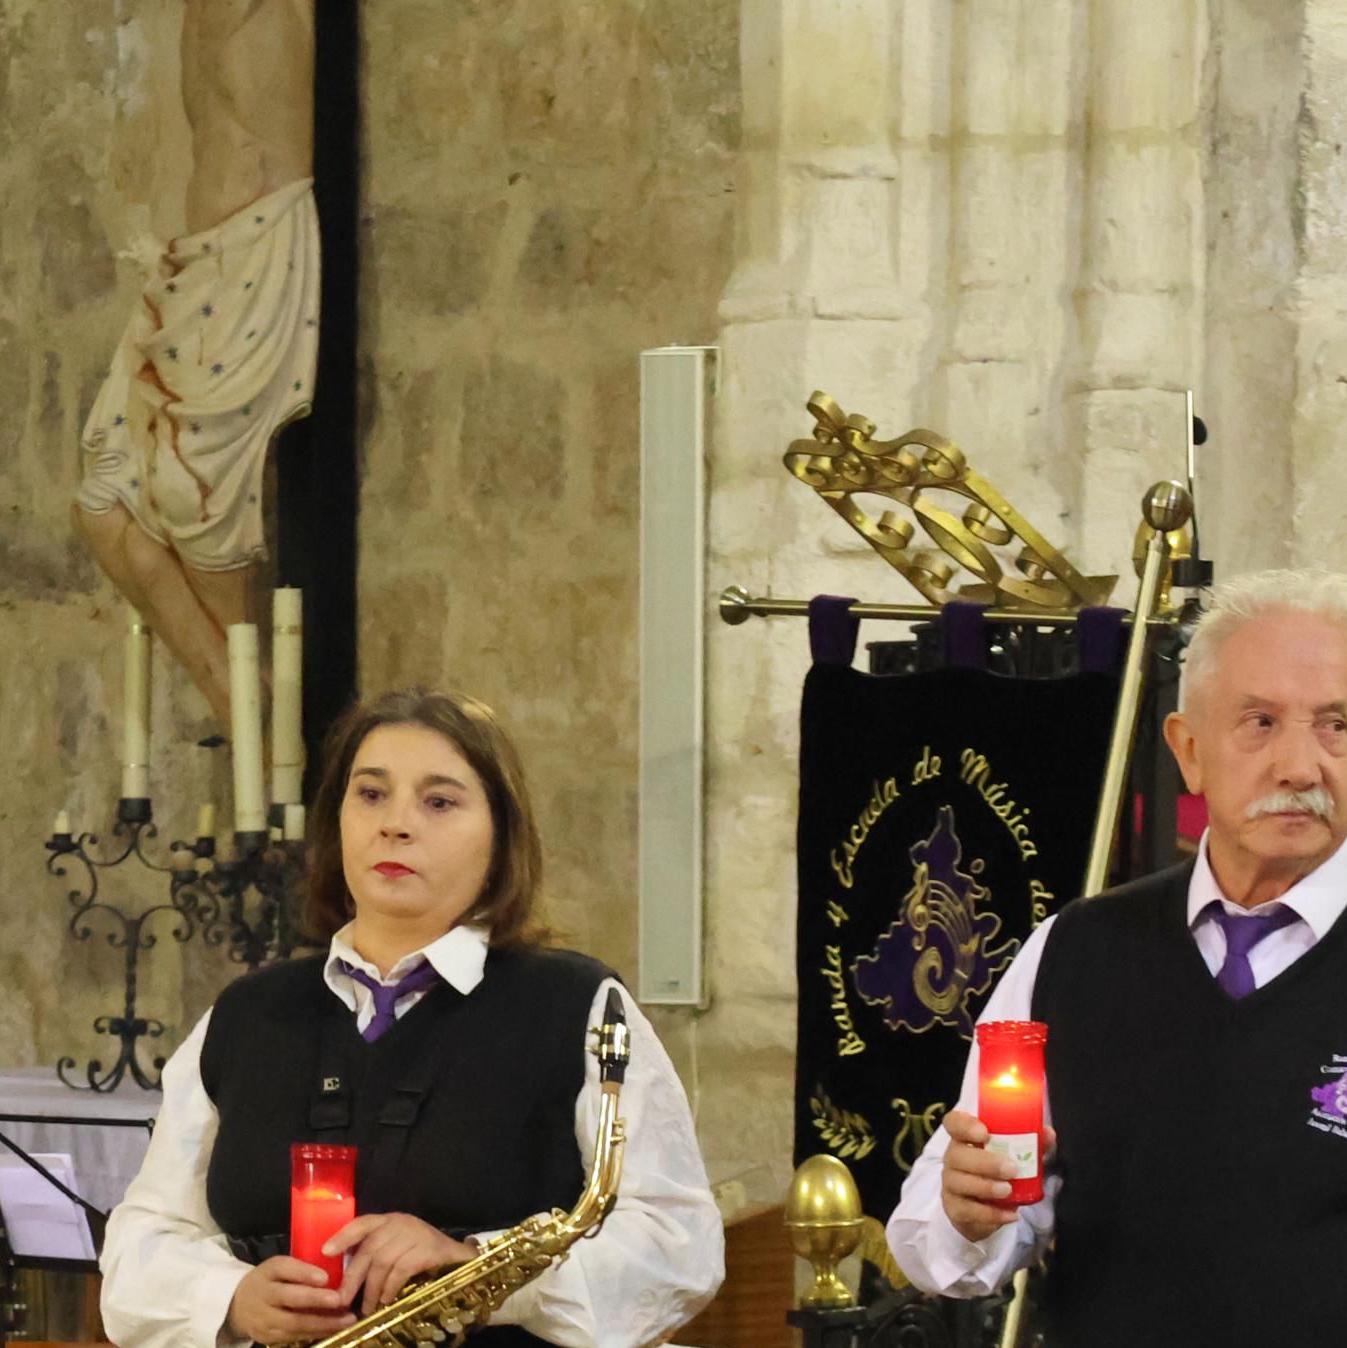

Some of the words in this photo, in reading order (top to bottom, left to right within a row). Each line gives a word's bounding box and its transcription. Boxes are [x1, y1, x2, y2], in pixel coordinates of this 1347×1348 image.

[911, 745, 941, 786] de
[960, 748, 1038, 861] Música
[830, 777, 900, 888] Escuela
[826, 899, 850, 928] y
[820, 944, 866, 1056] Banda
